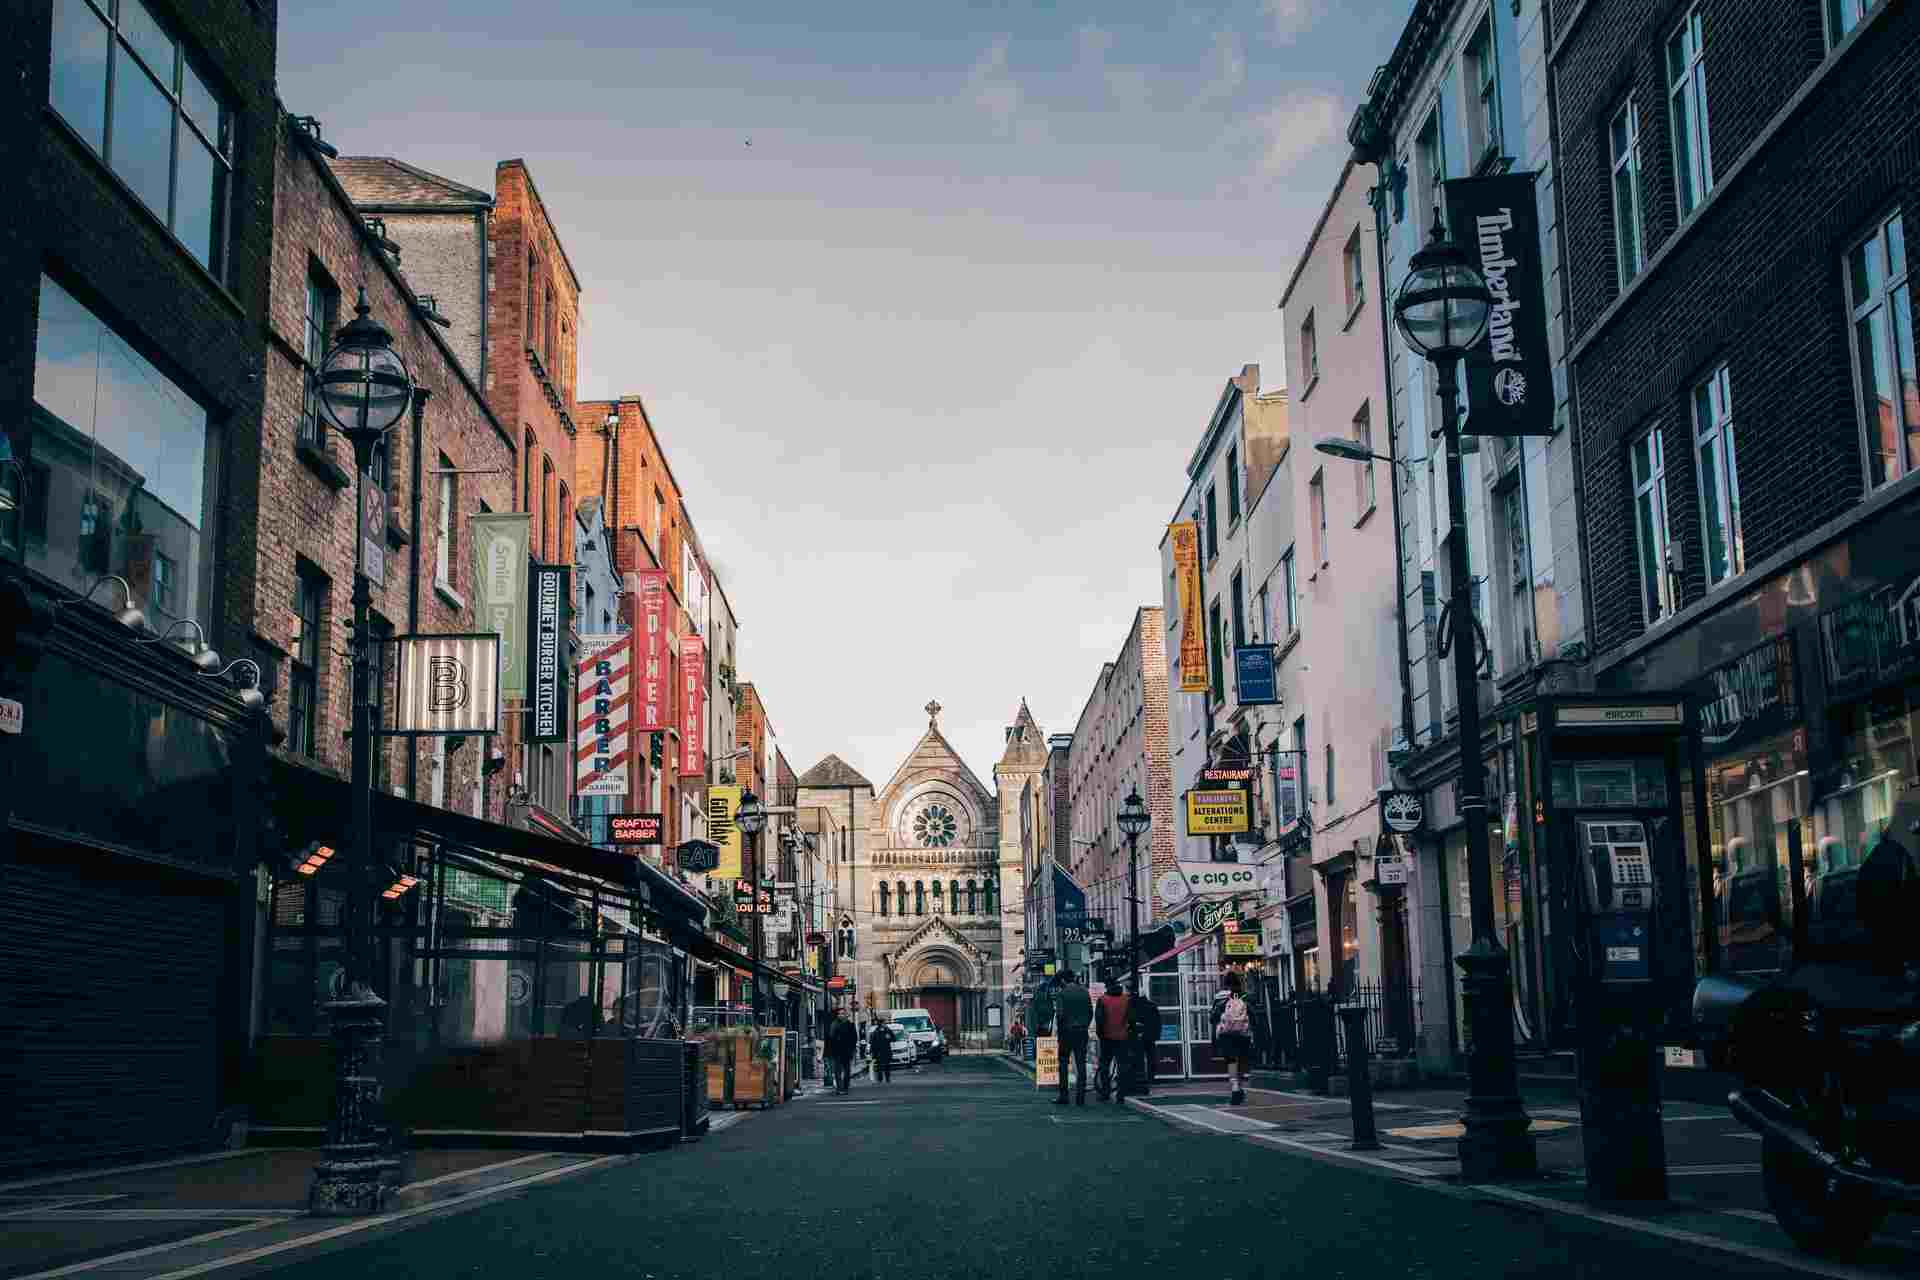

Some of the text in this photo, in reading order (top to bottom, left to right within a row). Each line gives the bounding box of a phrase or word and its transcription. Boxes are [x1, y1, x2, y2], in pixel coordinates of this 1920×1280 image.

[1475, 207, 1523, 363] Timberland
[538, 571, 556, 737] GOURMET BURGER KITCHEN
[644, 613, 660, 726] DINER
[427, 655, 471, 713] B
[593, 660, 613, 775] BARBER
[685, 675, 699, 772] DINER
[611, 818, 660, 830] GRAFTON
[1193, 806, 1245, 816] ALTERATIONS
[1204, 816, 1233, 825] CENTRE
[614, 828, 658, 841] BARBER
[678, 846, 714, 867] EAT
[1203, 872, 1228, 886] cig
[1231, 871, 1253, 883] co
